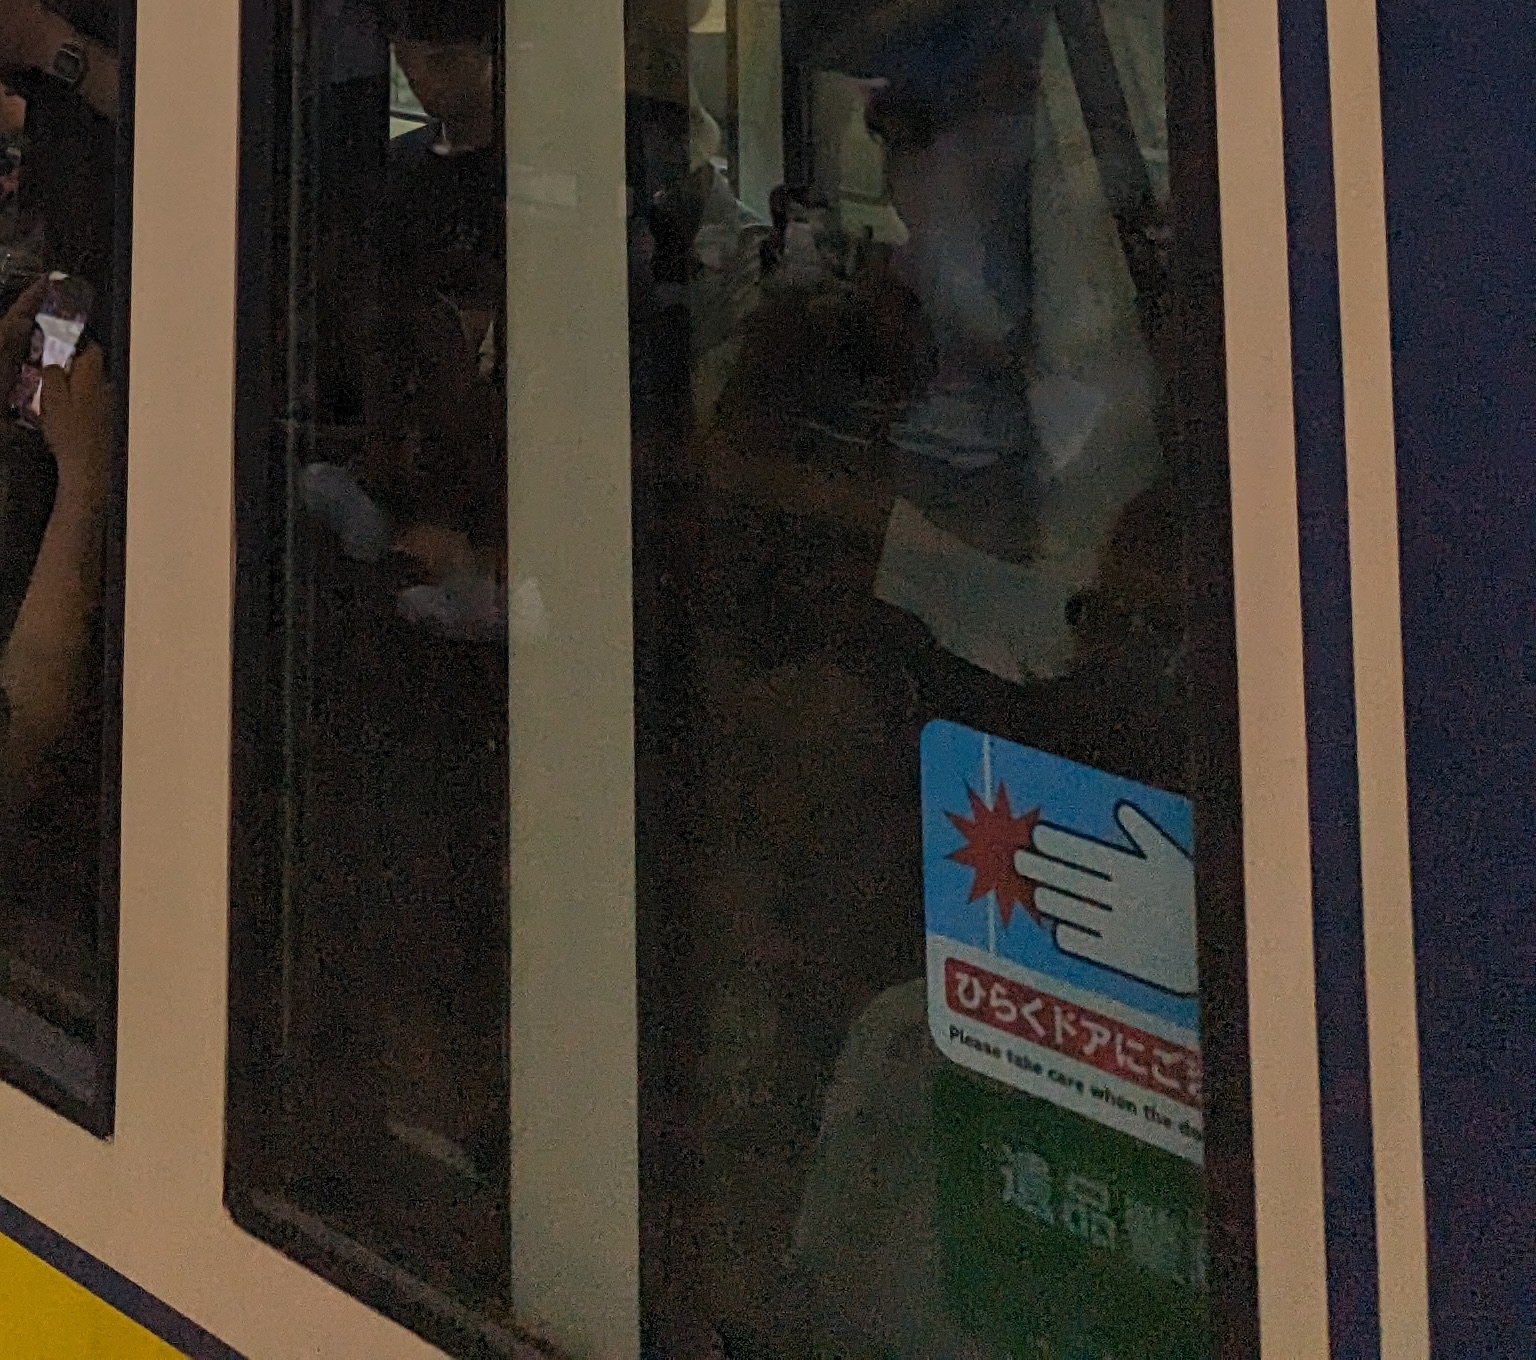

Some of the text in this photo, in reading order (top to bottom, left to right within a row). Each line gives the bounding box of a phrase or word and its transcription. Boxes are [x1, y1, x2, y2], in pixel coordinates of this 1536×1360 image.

[948, 1023, 1002, 1059] Please
[1006, 1048, 1043, 1077] take
[1047, 1068, 1085, 1097] care
[1090, 1082, 1138, 1116] when
[1142, 1104, 1172, 1128] the
